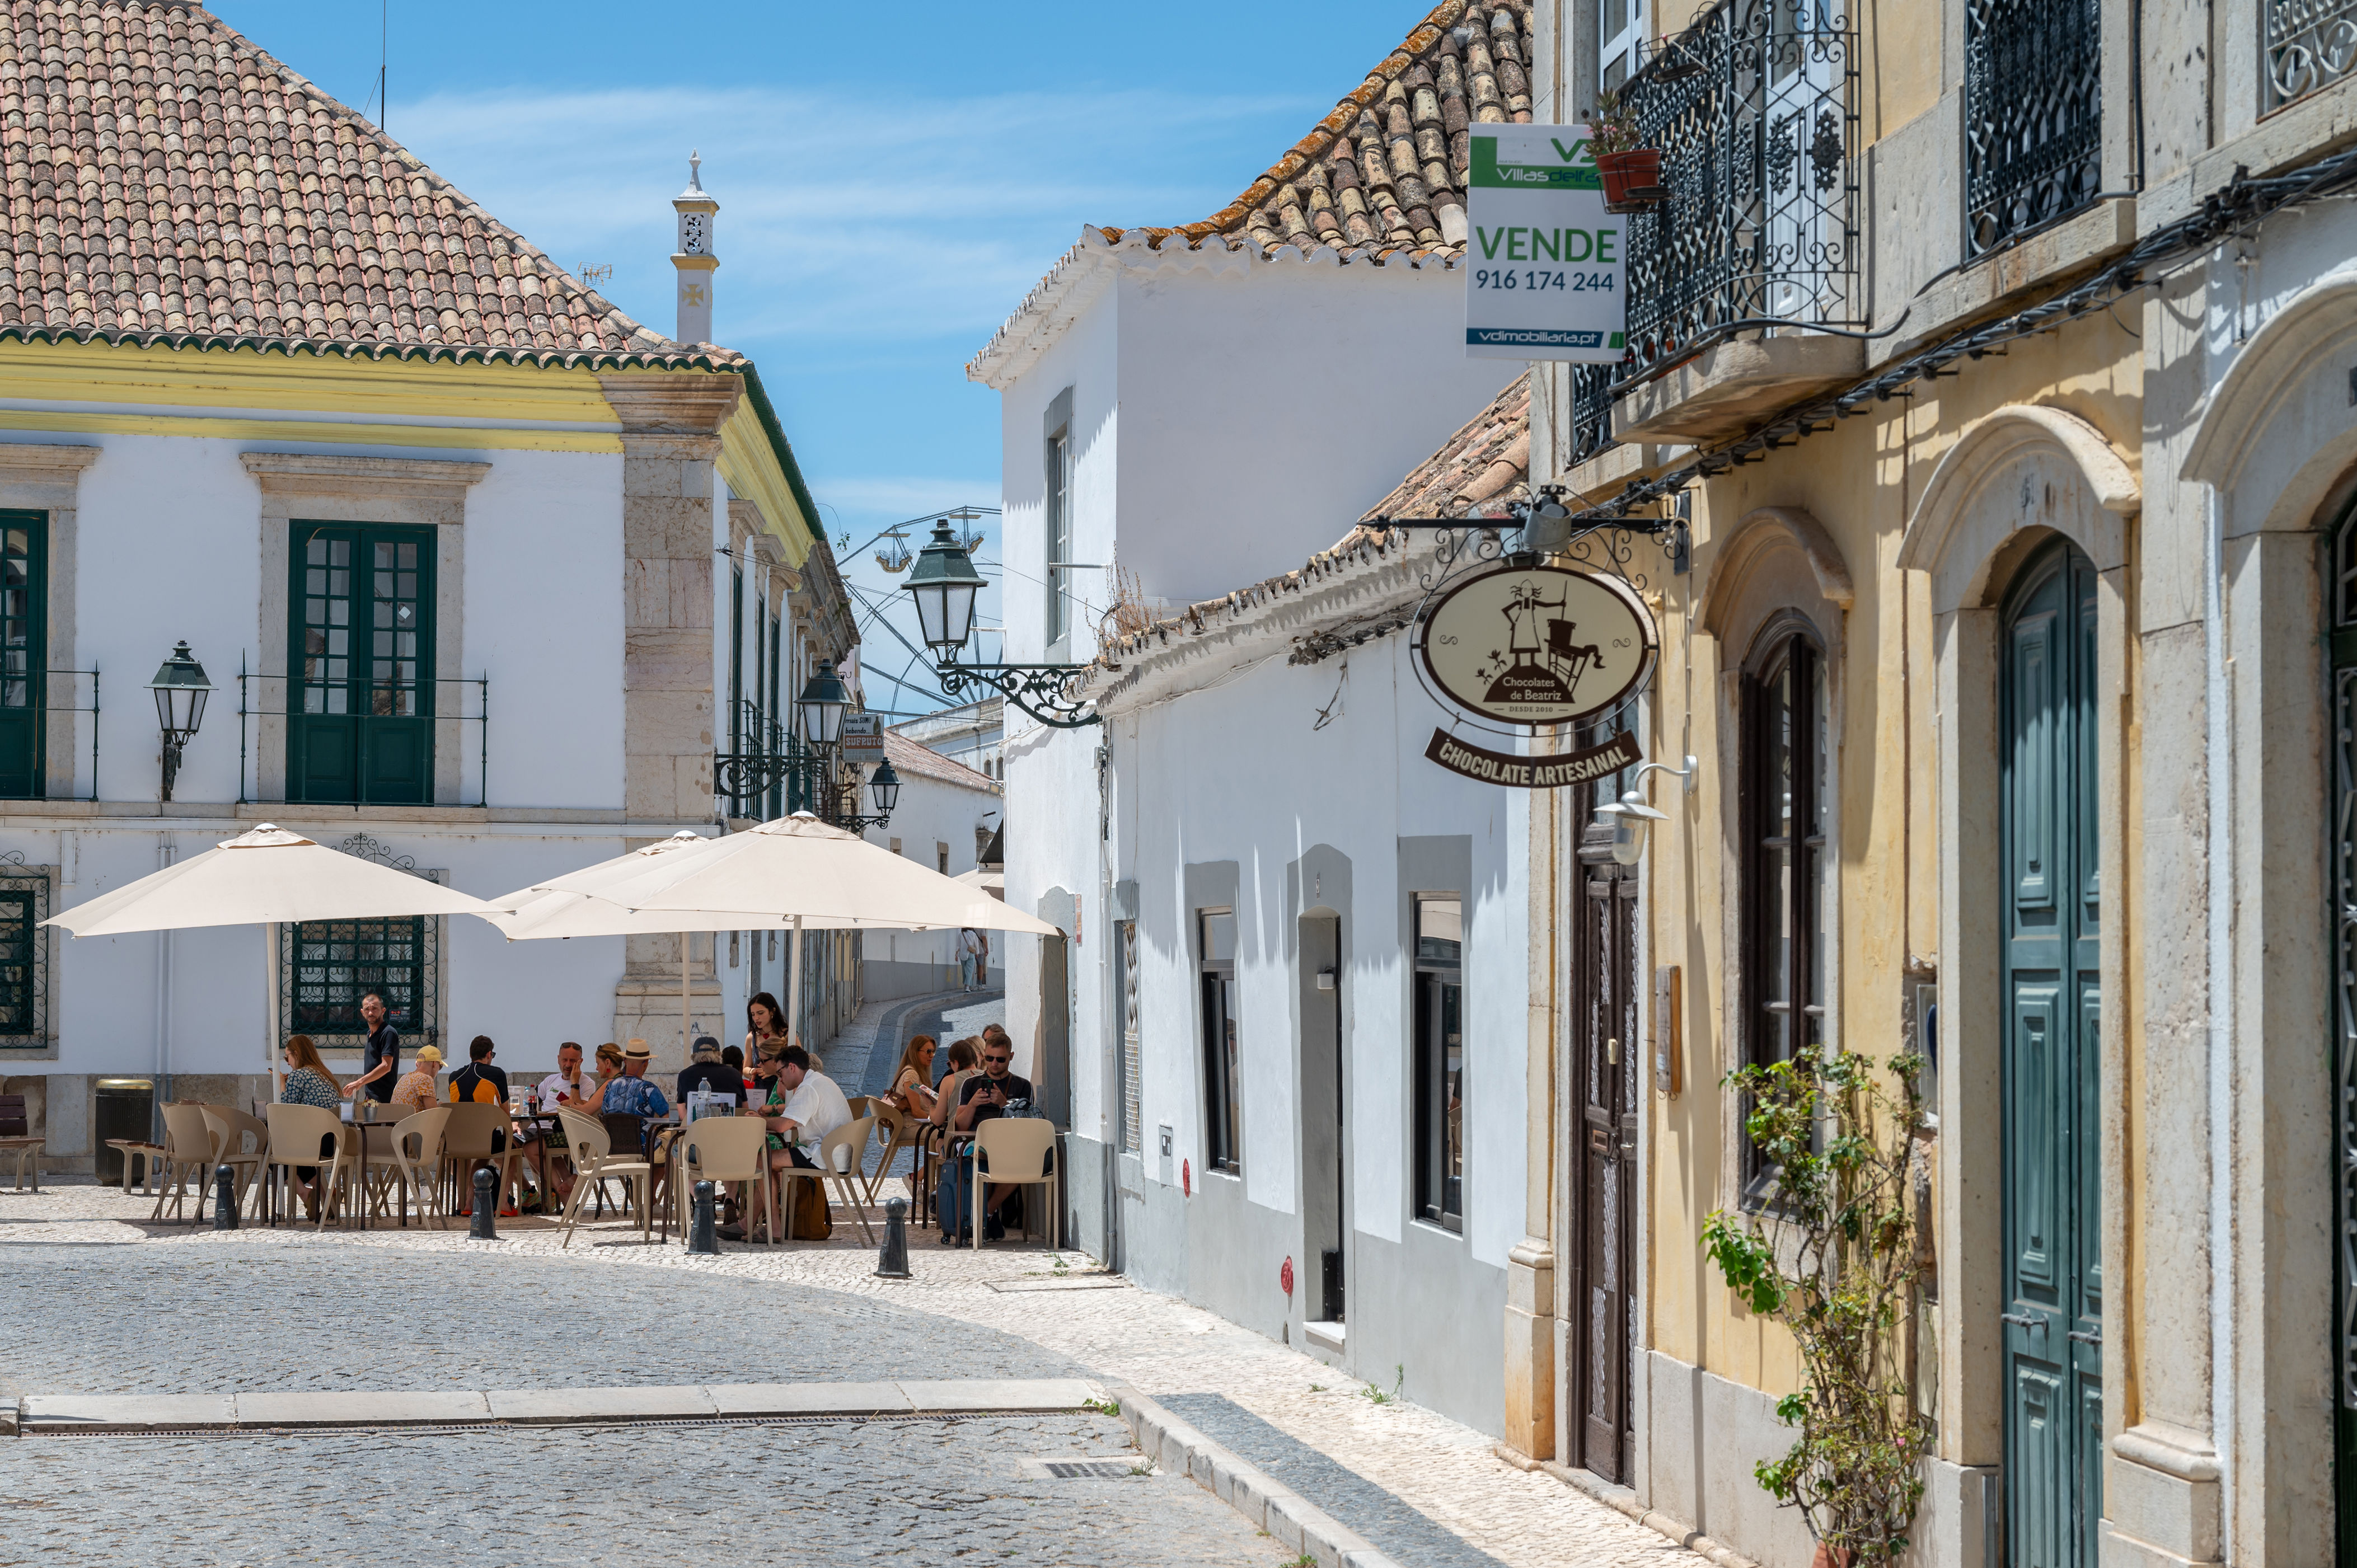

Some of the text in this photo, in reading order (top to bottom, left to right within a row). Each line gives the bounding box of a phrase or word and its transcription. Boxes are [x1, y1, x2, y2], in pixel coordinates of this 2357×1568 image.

[1496, 167, 1599, 183] Villasdelfa
[1475, 226, 1618, 263] VENDE
[1476, 269, 1615, 292] 916 174 244
[1478, 330, 1597, 345] vdimobiliaria.pt
[1502, 677, 1555, 687] Chocolates
[1510, 689, 1562, 700] de Beatriz
[846, 736, 882, 746] SUFRUTO
[1439, 741, 1631, 785] CHOCOLATE ARTESANAL
